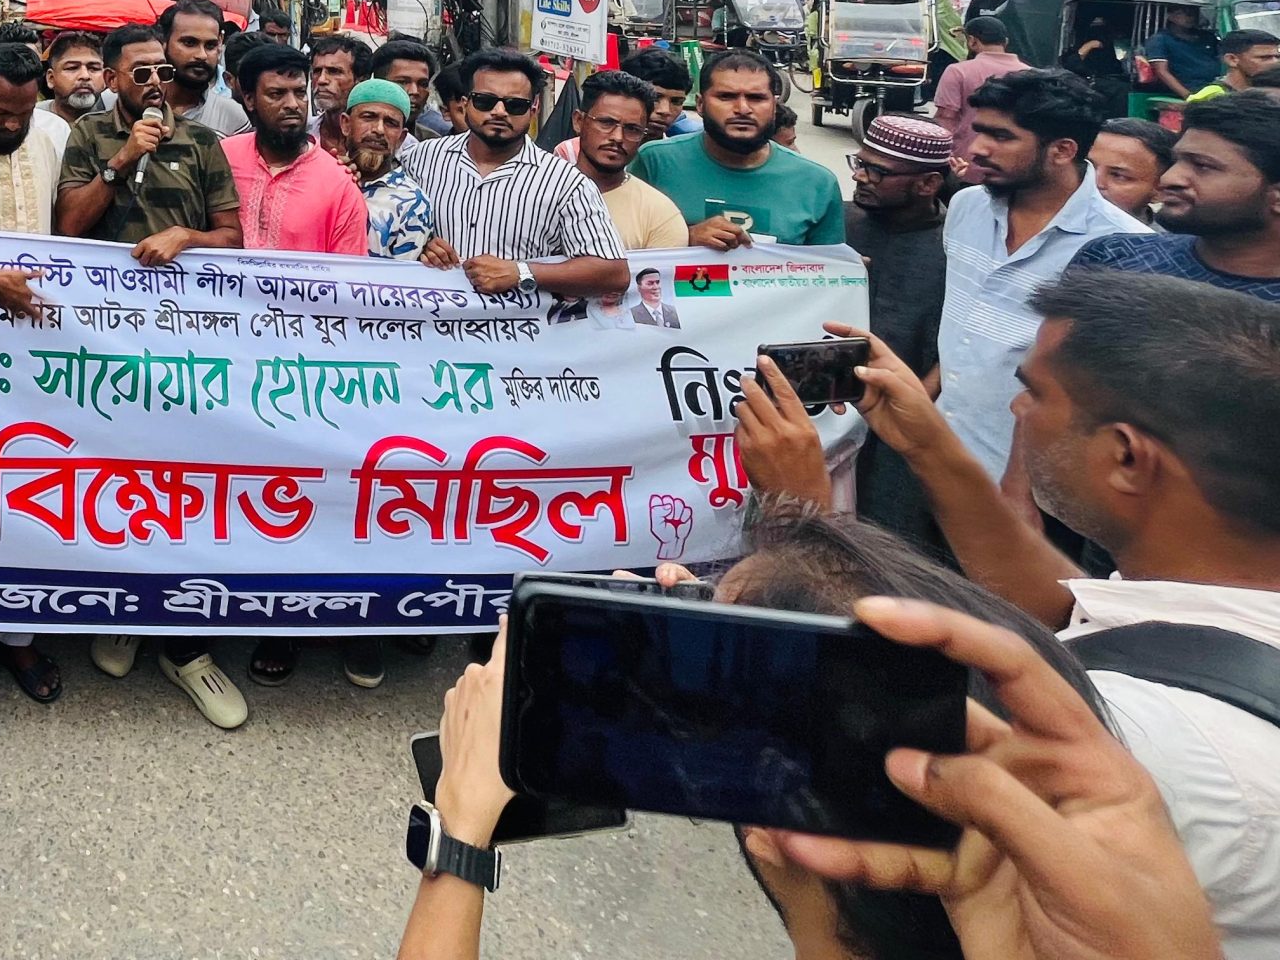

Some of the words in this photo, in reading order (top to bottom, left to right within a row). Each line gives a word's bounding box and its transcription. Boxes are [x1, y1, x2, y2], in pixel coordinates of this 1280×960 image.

[83, 262, 190, 296] আওয়ামী
[196, 265, 247, 298] লীগ
[254, 272, 338, 305] আমলে
[346, 281, 468, 318] দায়েরকৃত
[740, 263, 783, 275] বাংলাদেশ
[786, 261, 826, 274] জিন্দাবাদ
[72, 302, 148, 333] আটক
[154, 299, 241, 338] শ্রীমঙ্গল
[250, 303, 305, 340] পৌর
[310, 314, 348, 347] যুব
[356, 316, 427, 342] দলের
[28, 345, 233, 421] সারোয়ার
[250, 352, 401, 430] হোসেন
[420, 359, 494, 415] এর
[500, 366, 545, 408] মুক্তির
[546, 367, 601, 404] দাবিতে
[350, 435, 634, 565] মিছিল
[162, 578, 381, 620] শ্রীমঙ্গল
